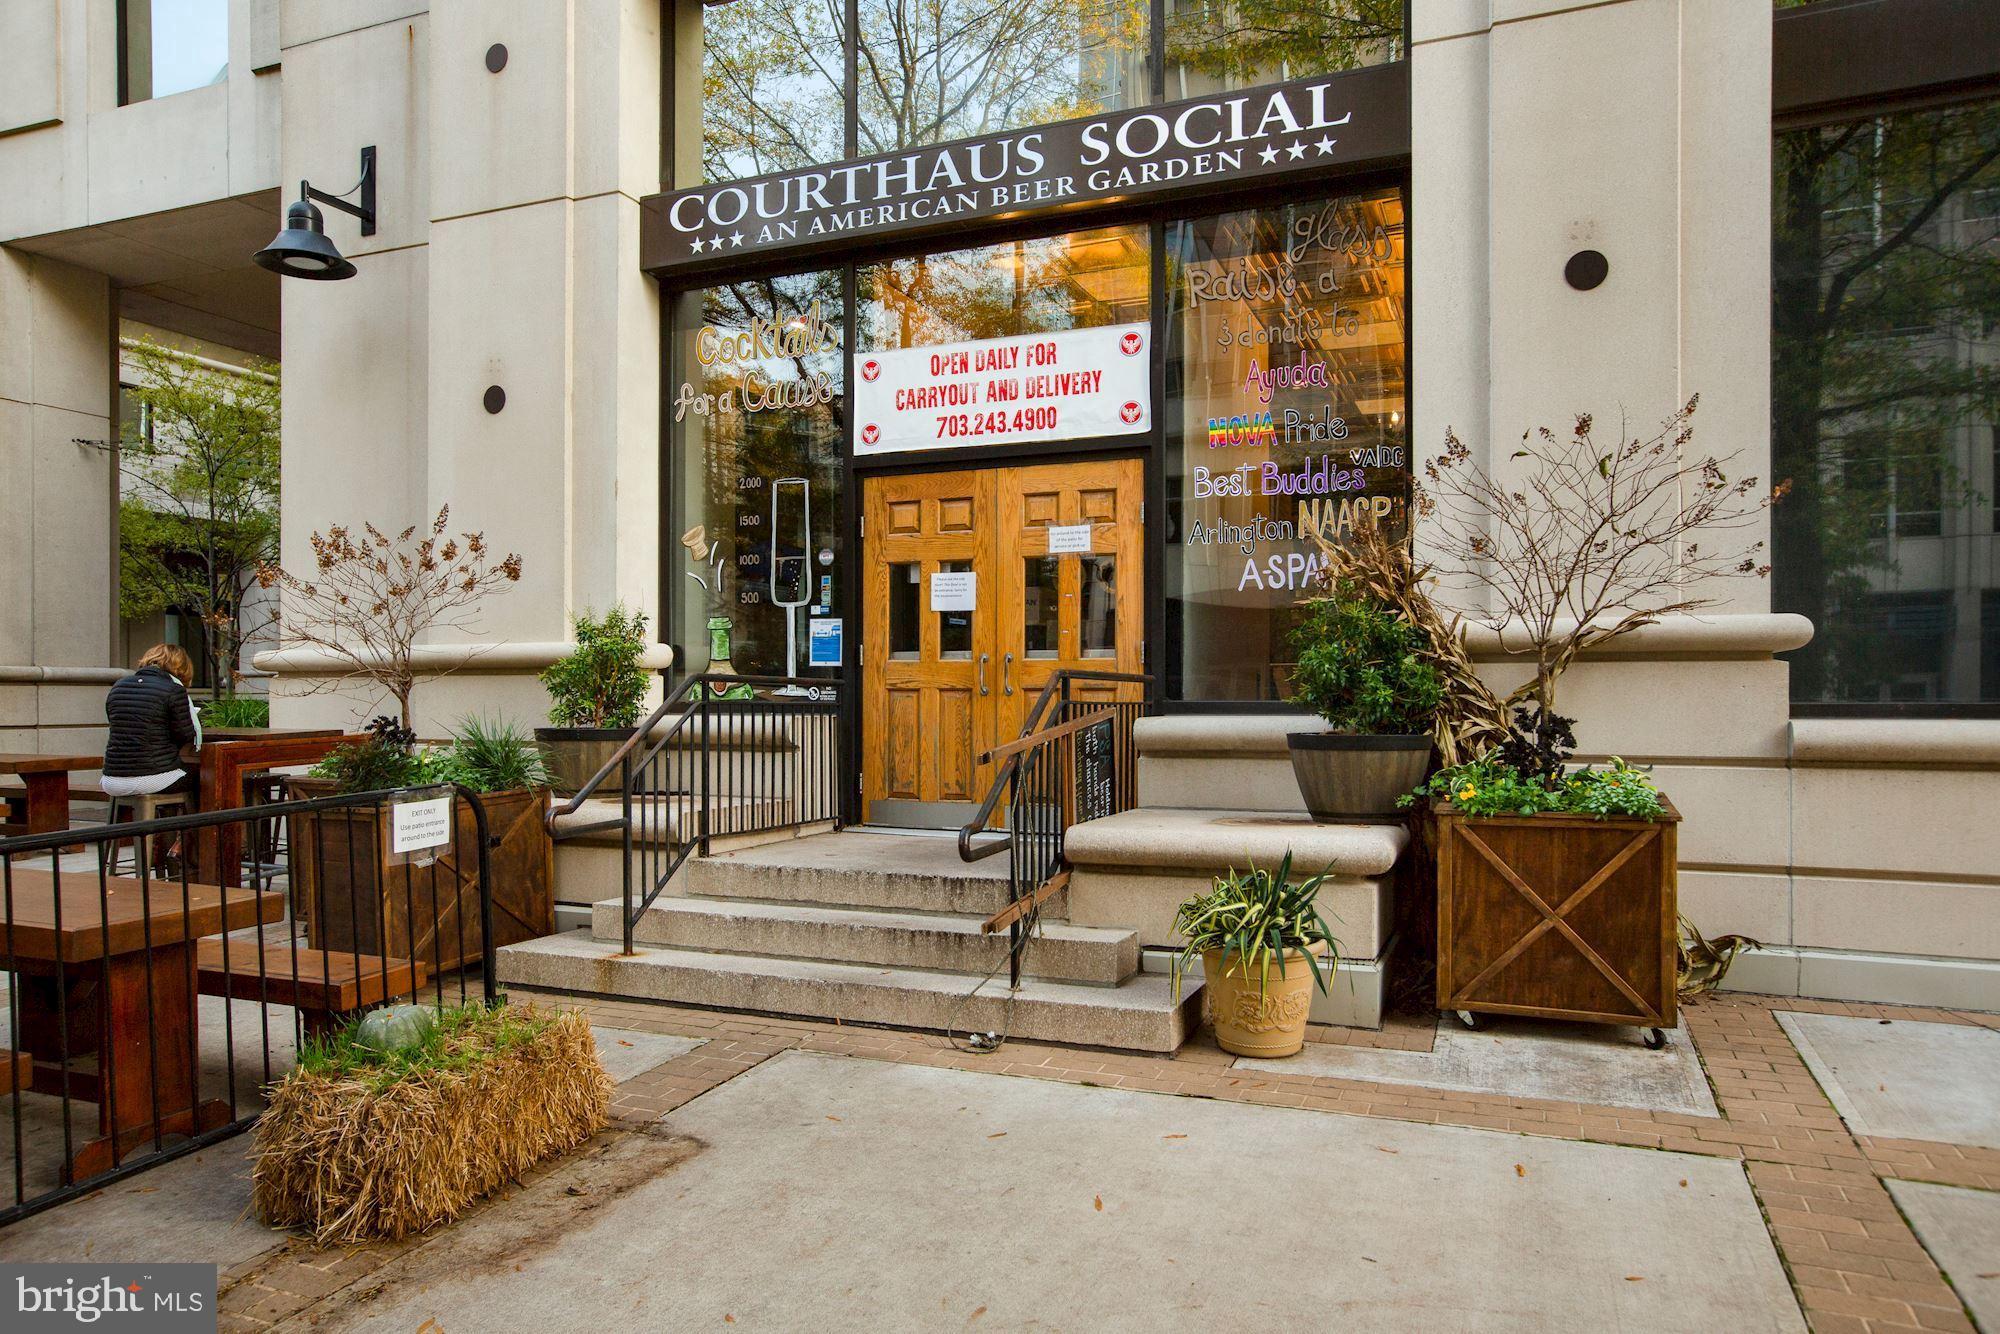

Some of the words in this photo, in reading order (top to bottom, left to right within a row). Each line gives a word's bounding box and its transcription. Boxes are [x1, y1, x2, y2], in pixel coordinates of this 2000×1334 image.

[669, 135, 1045, 232] COURTHAUS
[1081, 83, 1351, 166] SOCIAL
[756, 220, 798, 245] AN
[808, 190, 980, 236] AMERICAN
[990, 175, 1077, 208] BEER
[1087, 148, 1245, 191] GARDEN
[1185, 258, 1297, 309] Raise
[1290, 201, 1392, 263] glass
[696, 299, 839, 366] Cocktails
[1238, 306, 1323, 348] donate
[1324, 301, 1360, 337] to
[930, 351, 969, 377] OPEN
[975, 346, 1019, 372] DAILY
[1026, 342, 1057, 367] FOR
[1244, 350, 1329, 404] Ayuda
[674, 382, 715, 422] for
[718, 391, 734, 413] a
[742, 370, 834, 412] Cause
[895, 381, 980, 412] CARRYOUT
[986, 378, 1019, 403] AND
[1025, 370, 1103, 400] DELIVERY
[936, 406, 1057, 438] 703.243.4900
[1208, 411, 1278, 449] NOVA
[1284, 405, 1349, 444] Pride
[739, 477, 761, 489] 2000
[1193, 463, 1257, 498] Best
[1261, 454, 1366, 497] Buddies
[739, 515, 760, 526] 1500
[1188, 512, 1293, 555] Arlington
[739, 554, 760, 565] 1000
[1238, 551, 1329, 592] A-SPA
[741, 592, 759, 604] 500
[400, 823, 412, 831] Use
[411, 809, 423, 818] EXIT
[424, 808, 436, 816] ONLY
[401, 833, 420, 842] around
